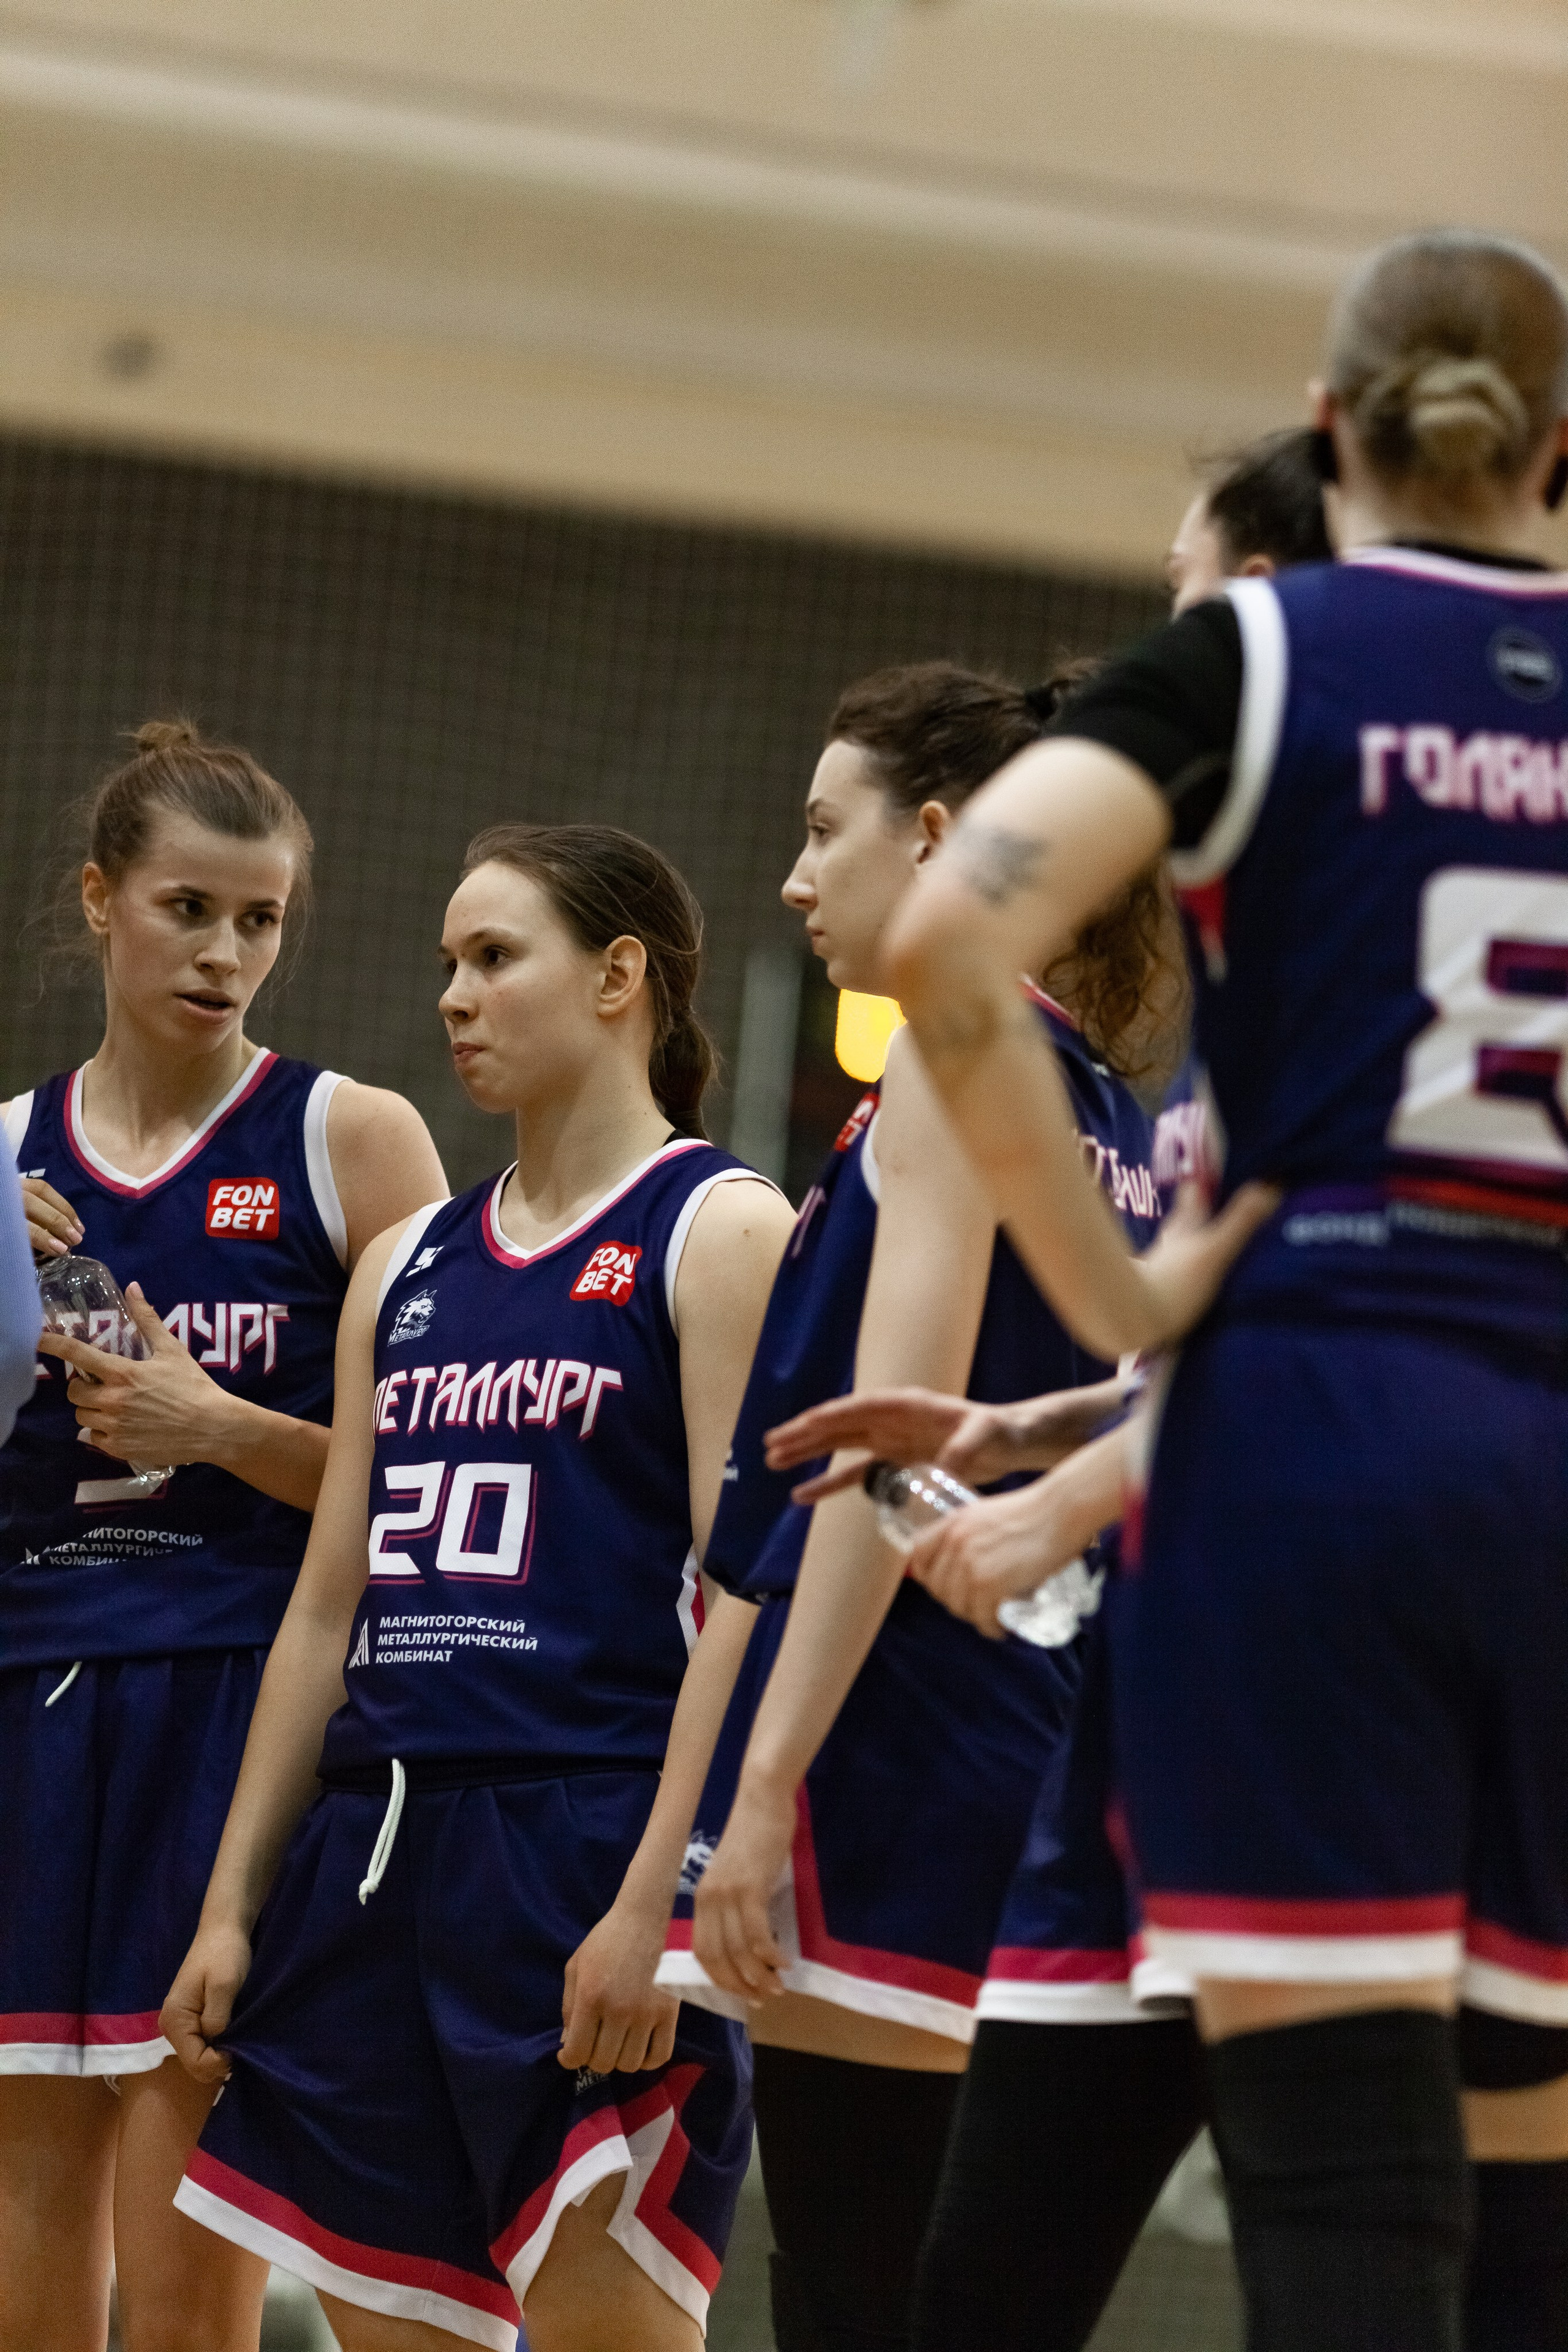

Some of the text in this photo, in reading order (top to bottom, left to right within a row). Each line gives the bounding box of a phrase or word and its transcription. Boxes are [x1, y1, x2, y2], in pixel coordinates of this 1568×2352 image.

[213, 1185, 274, 1207] FON
[210, 1207, 275, 1231] BET
[586, 1246, 637, 1275] FON
[575, 1268, 632, 1295] BET
[369, 1461, 537, 1585] 20
[379, 1615, 525, 1633] МАГНИТОГОРСКИЙ
[377, 1633, 538, 1651] МЕТАЛЛУРГИЧЕСКИЙ
[375, 1650, 453, 1664] КОМБИНАТ
